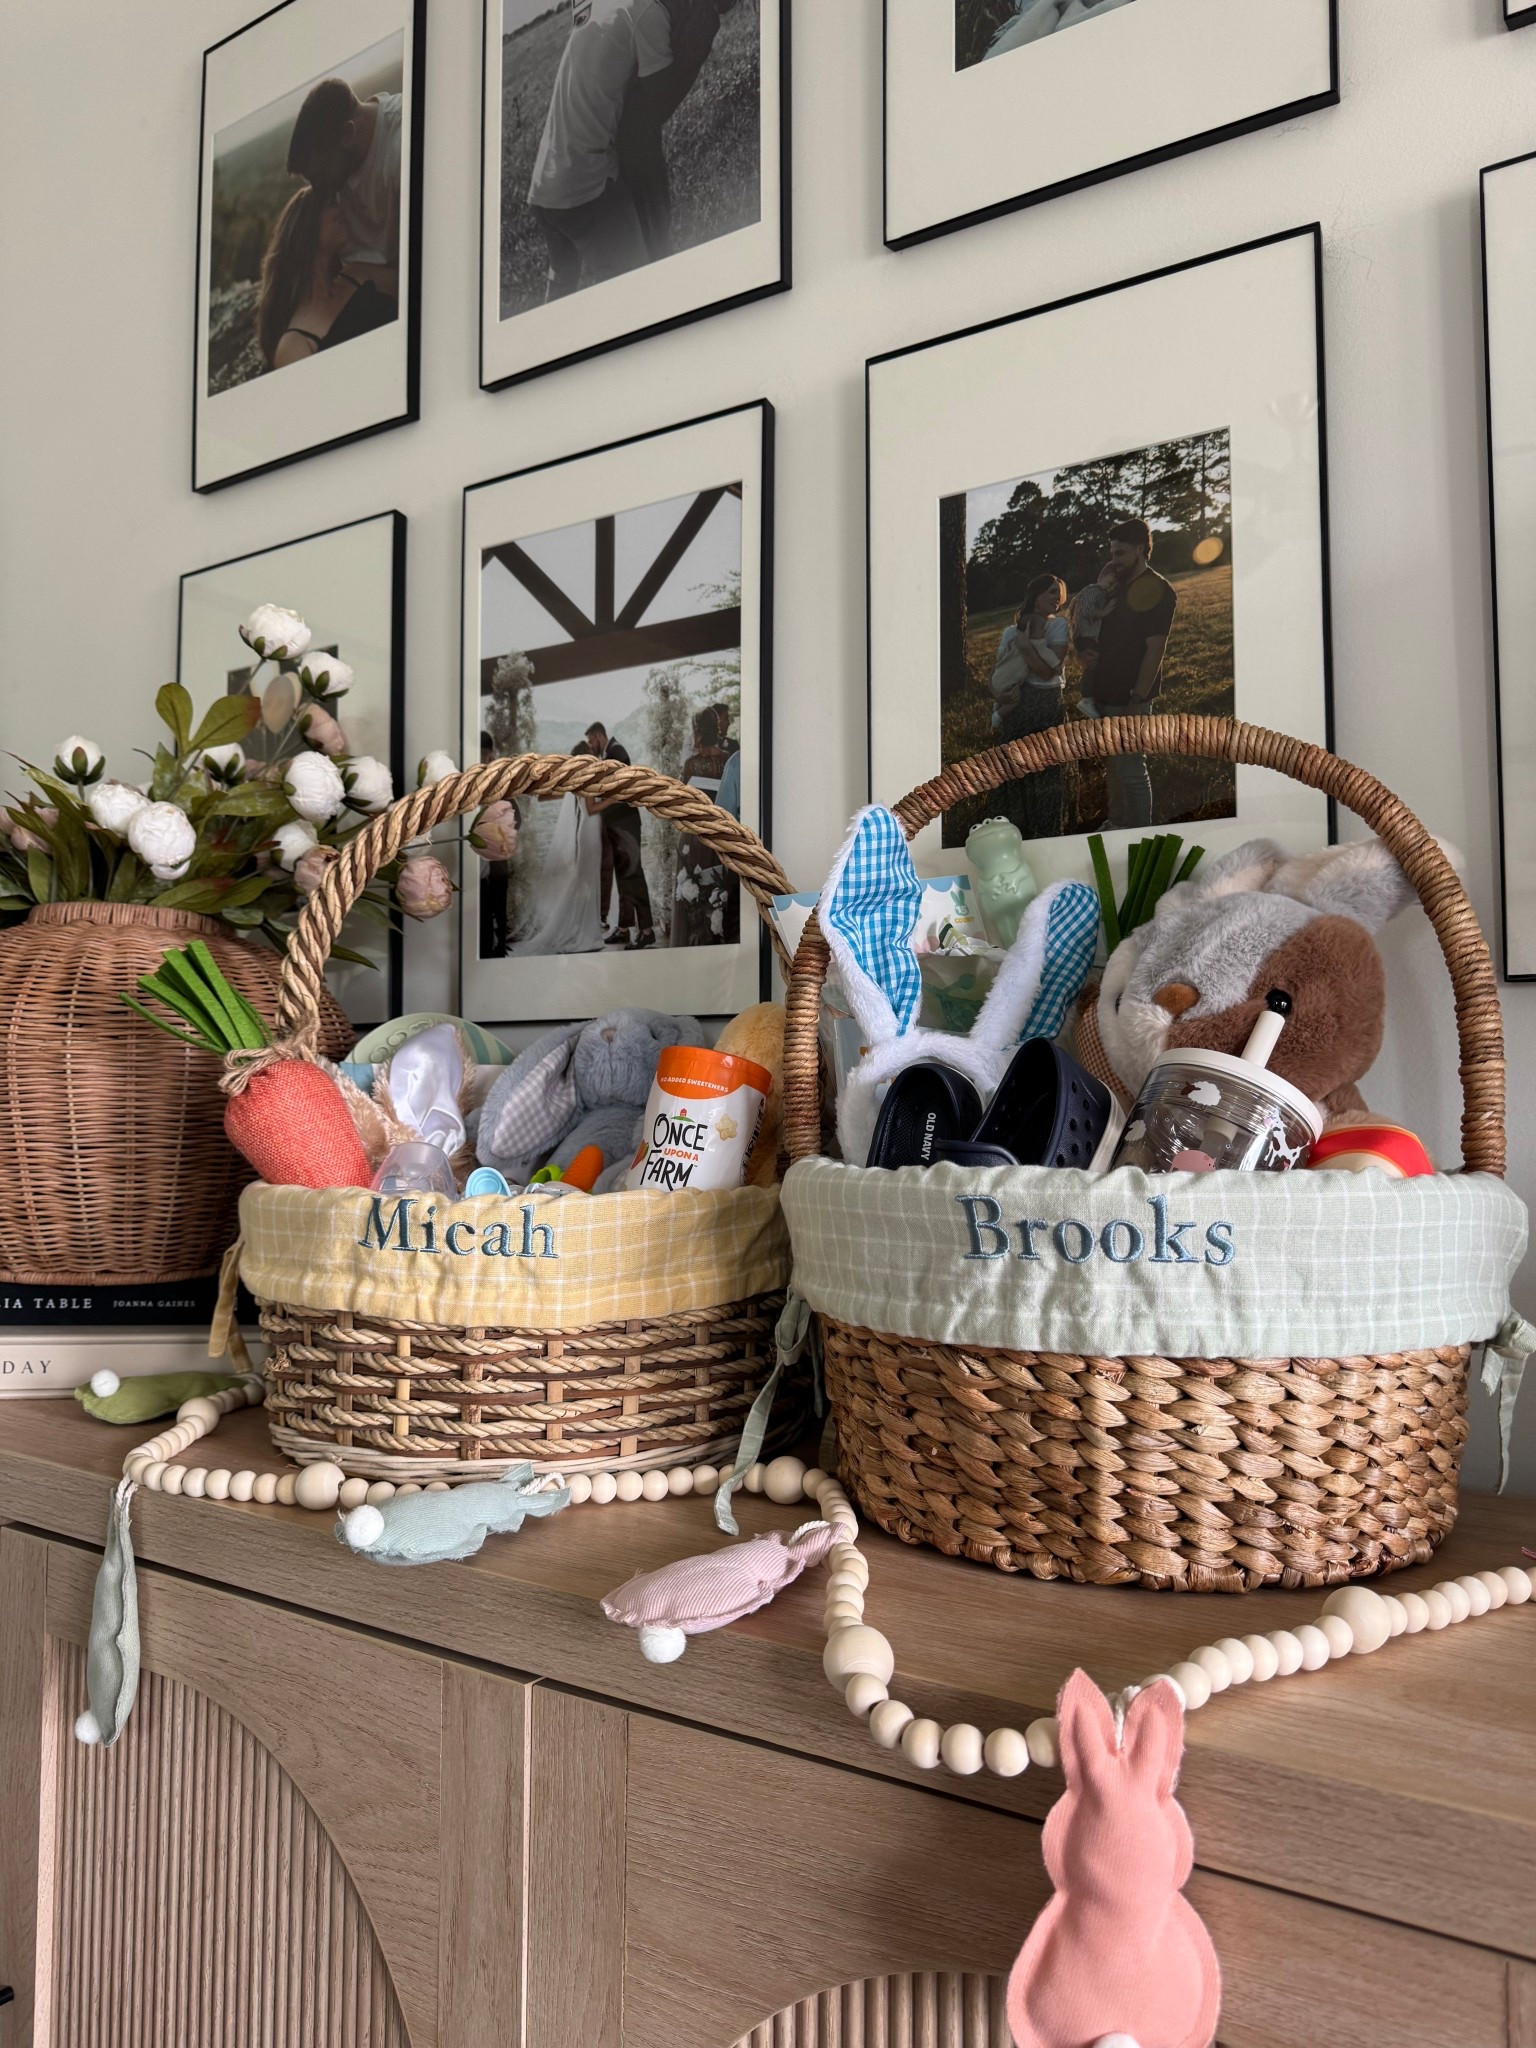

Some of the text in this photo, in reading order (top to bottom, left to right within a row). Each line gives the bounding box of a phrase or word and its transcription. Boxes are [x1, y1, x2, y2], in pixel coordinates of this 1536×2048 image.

[667, 1076, 687, 1084] ADDED
[687, 1078, 728, 1092] SWEETENERS
[653, 1113, 708, 1151] ONCE
[921, 1112, 936, 1160] OLD NAVY
[664, 1148, 693, 1161] UPON
[640, 1150, 693, 1191] FARM
[358, 1196, 559, 1258] Micah
[955, 1194, 1235, 1265] Brooks
[0, 1298, 93, 1309] IA TABLE
[113, 1300, 196, 1308] JOANNA GAINES
[3, 1360, 51, 1374] DAY
